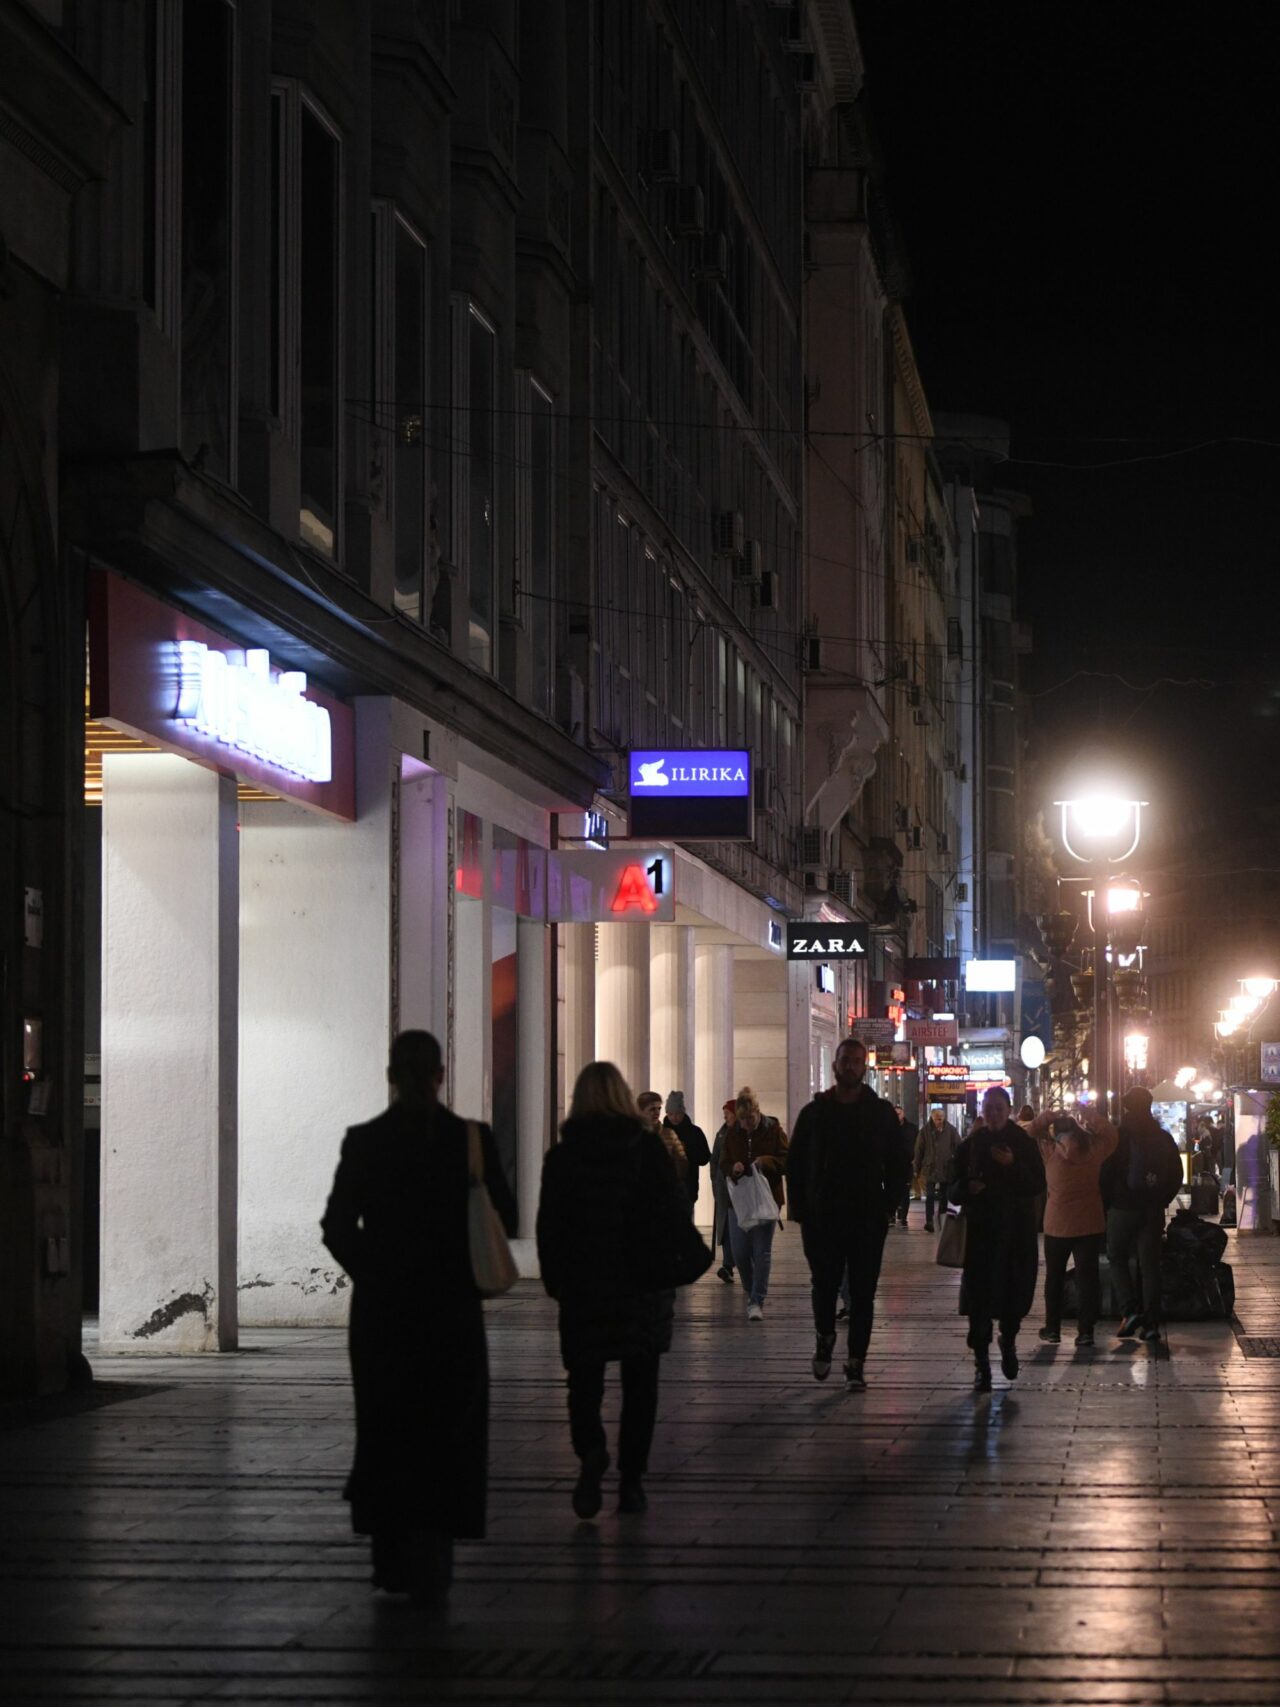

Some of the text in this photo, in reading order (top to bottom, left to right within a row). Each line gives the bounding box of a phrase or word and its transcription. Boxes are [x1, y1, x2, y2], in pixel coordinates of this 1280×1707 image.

[671, 767, 746, 781] ILIRIKA
[611, 858, 664, 911] A1
[792, 938, 865, 953] ZARA
